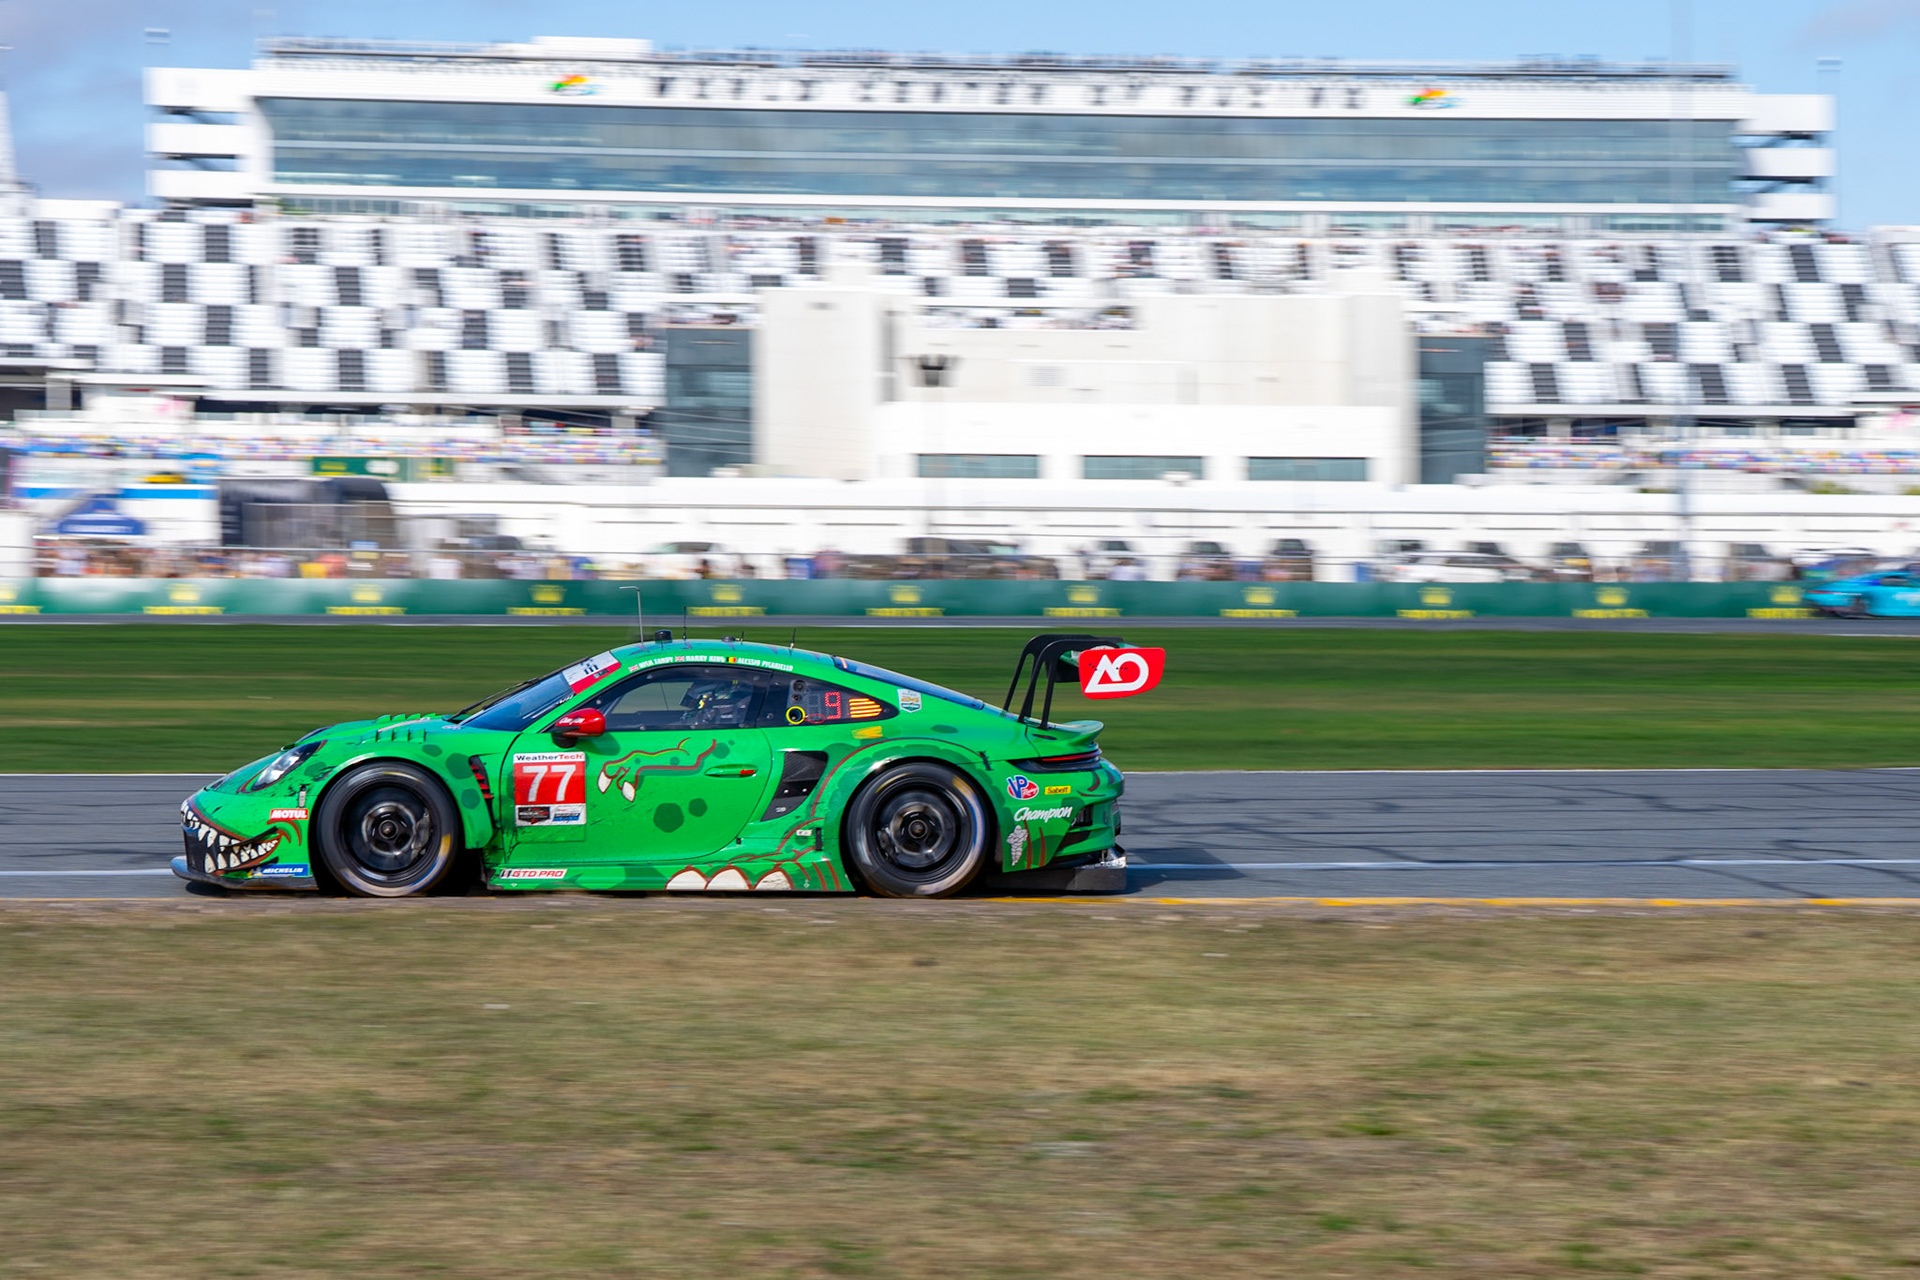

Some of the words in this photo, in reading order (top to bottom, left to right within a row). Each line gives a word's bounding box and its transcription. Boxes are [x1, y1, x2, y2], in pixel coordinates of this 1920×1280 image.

[516, 753, 582, 761] WeatherTech
[522, 764, 576, 802] 77
[1006, 775, 1028, 799] VP
[271, 810, 308, 819] MOTUL
[1014, 806, 1073, 823] Champion
[512, 870, 537, 878] GTD
[538, 870, 564, 878] PRO
